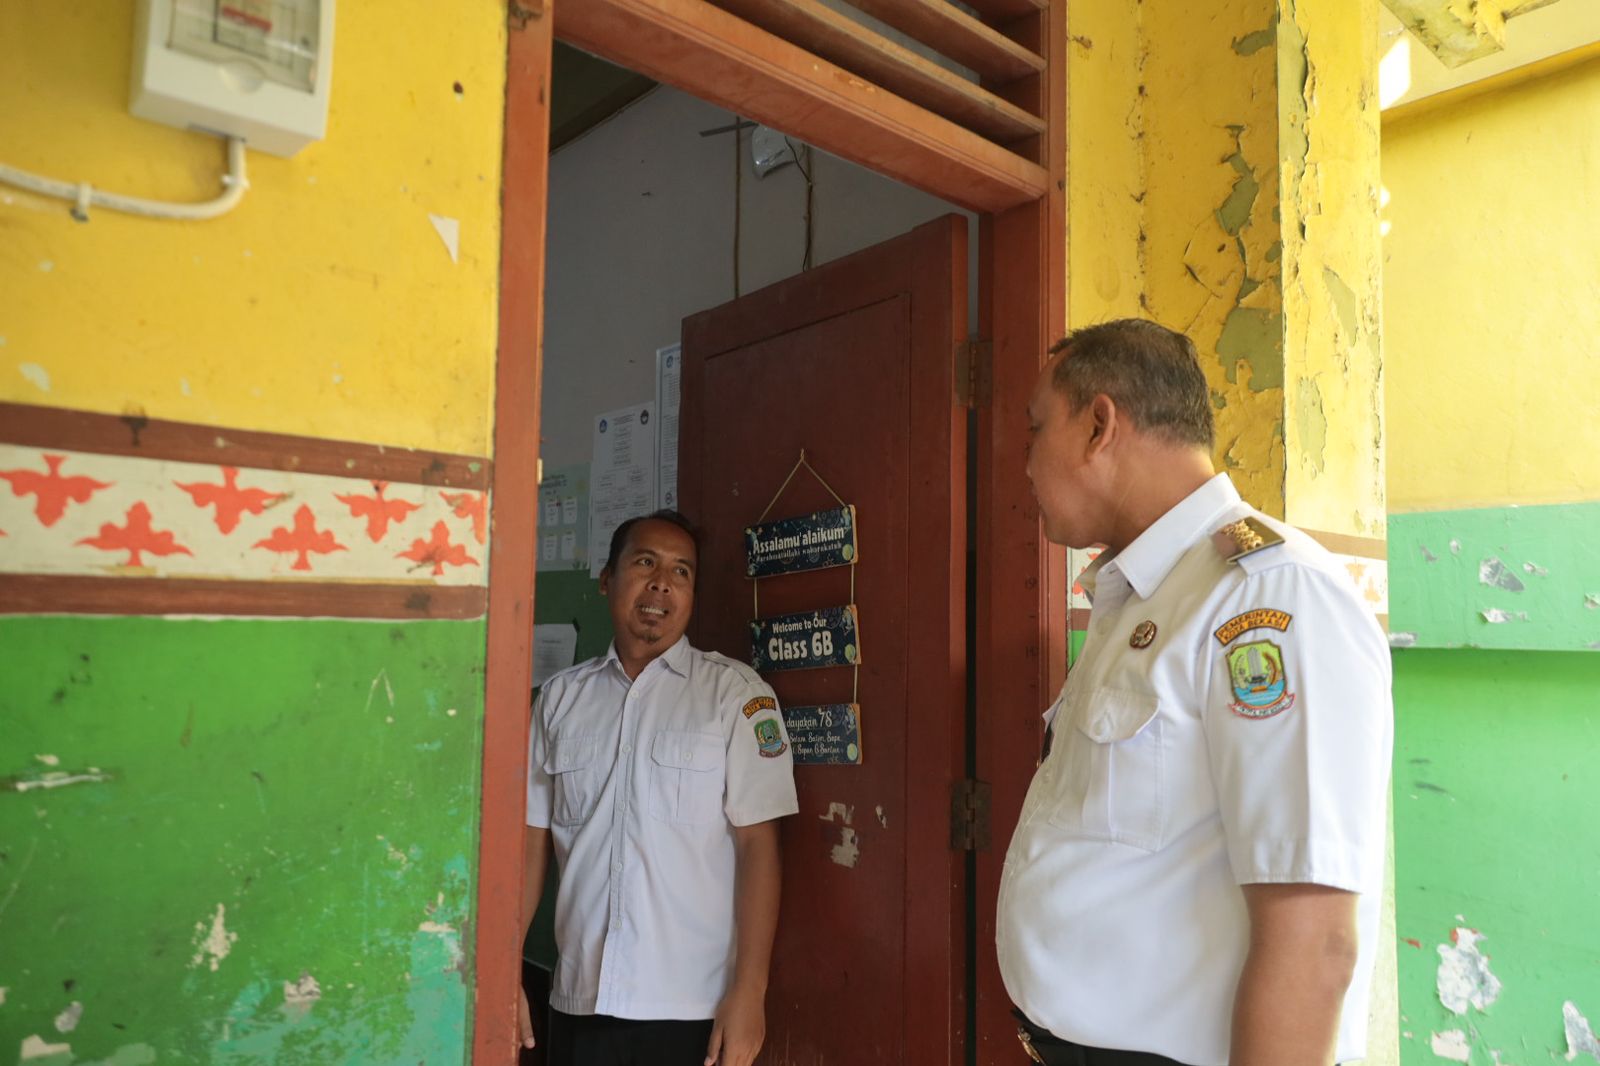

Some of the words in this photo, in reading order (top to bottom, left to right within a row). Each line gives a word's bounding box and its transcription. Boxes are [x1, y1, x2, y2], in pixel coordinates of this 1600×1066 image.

[772, 622, 802, 634] Welcome
[804, 618, 812, 629] to
[813, 617, 827, 627] Our
[1217, 610, 1289, 637] PEMERINTAH
[1222, 623, 1244, 641] KOTA
[1247, 617, 1284, 630] BEKASI
[768, 637, 807, 661] Class
[812, 630, 833, 657] 6B
